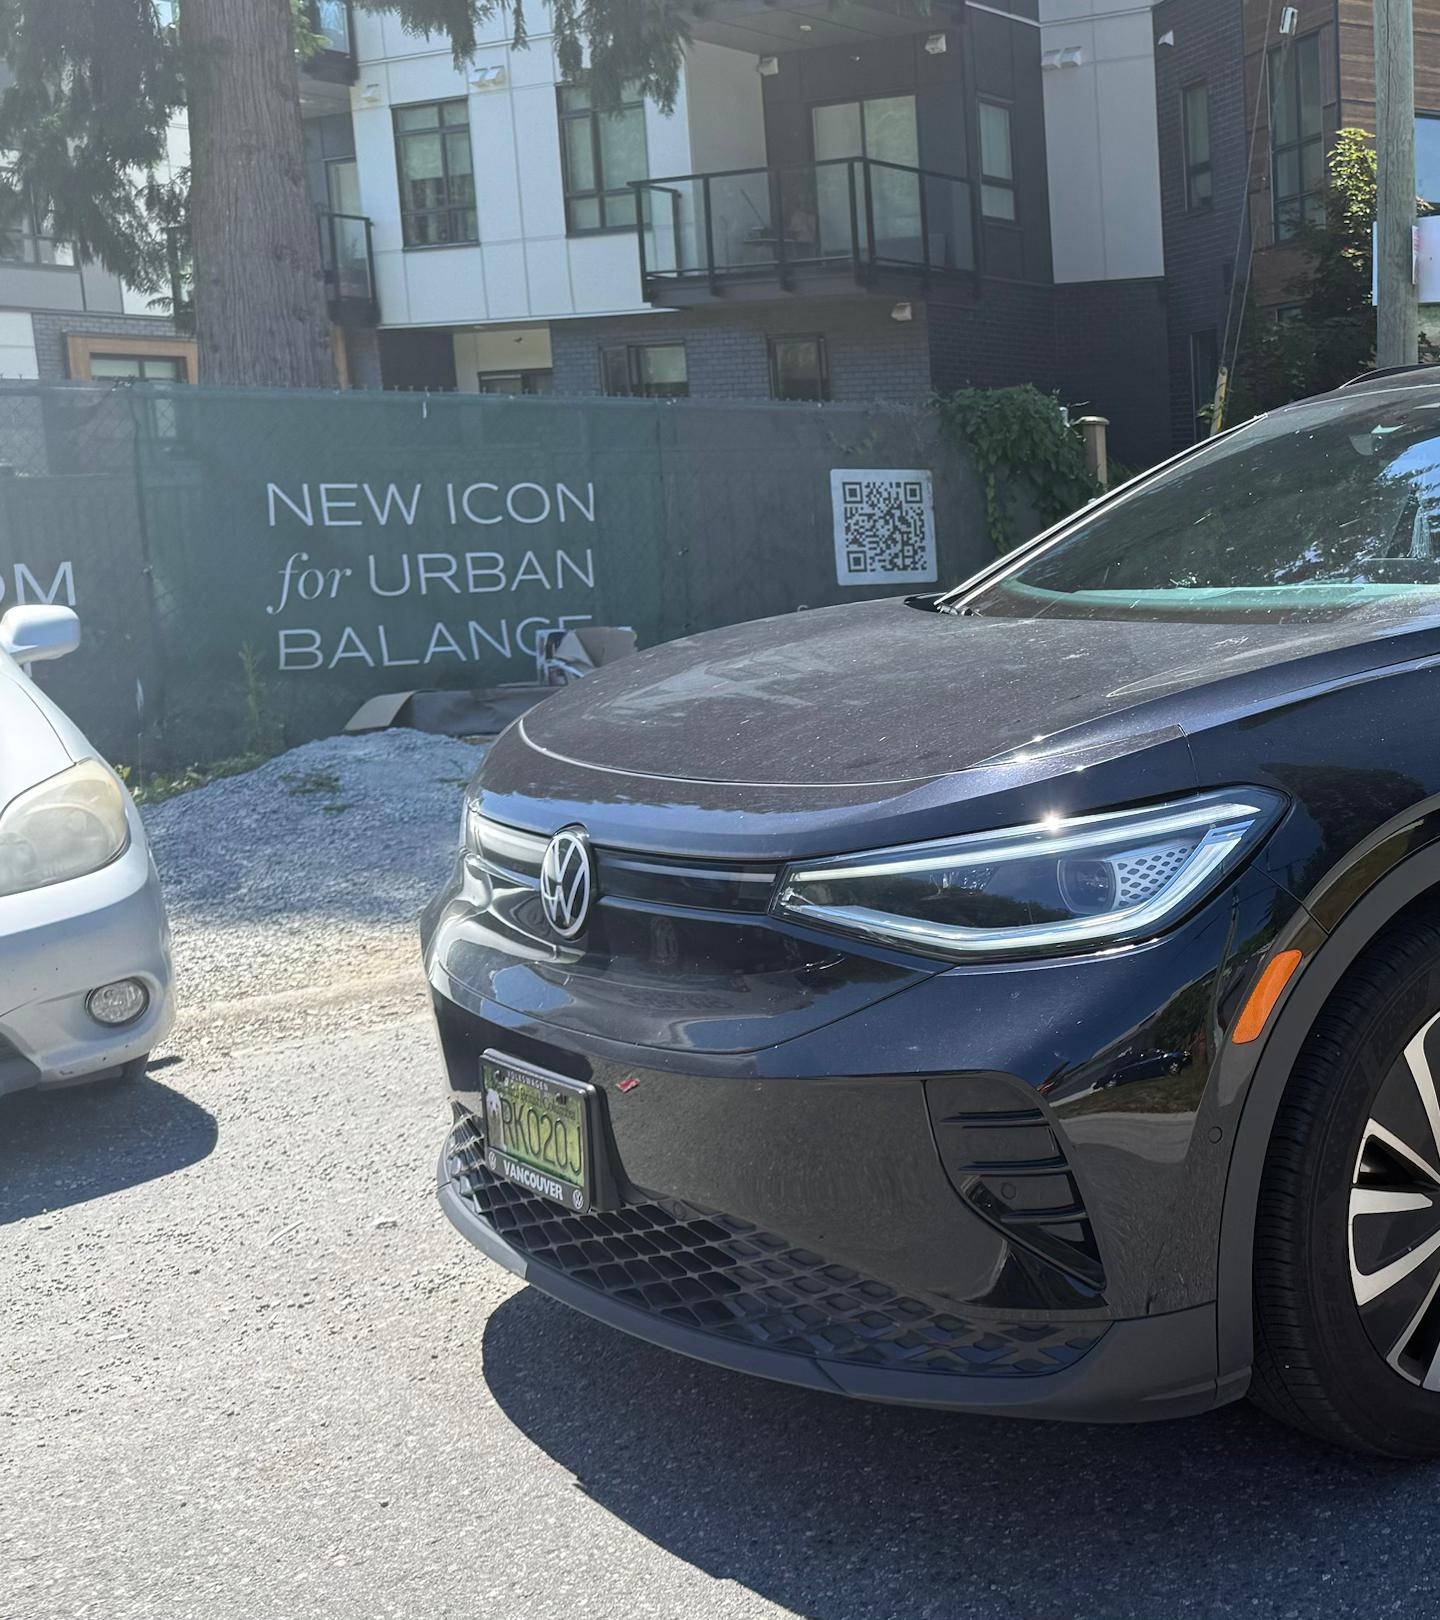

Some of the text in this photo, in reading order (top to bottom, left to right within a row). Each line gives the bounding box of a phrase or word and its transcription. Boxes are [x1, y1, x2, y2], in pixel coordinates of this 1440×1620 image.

[266, 482, 595, 526] NEW ICON
[0, 561, 76, 606] M
[266, 549, 595, 614] for URBAN
[503, 1159, 563, 1201] VANCOUVER
